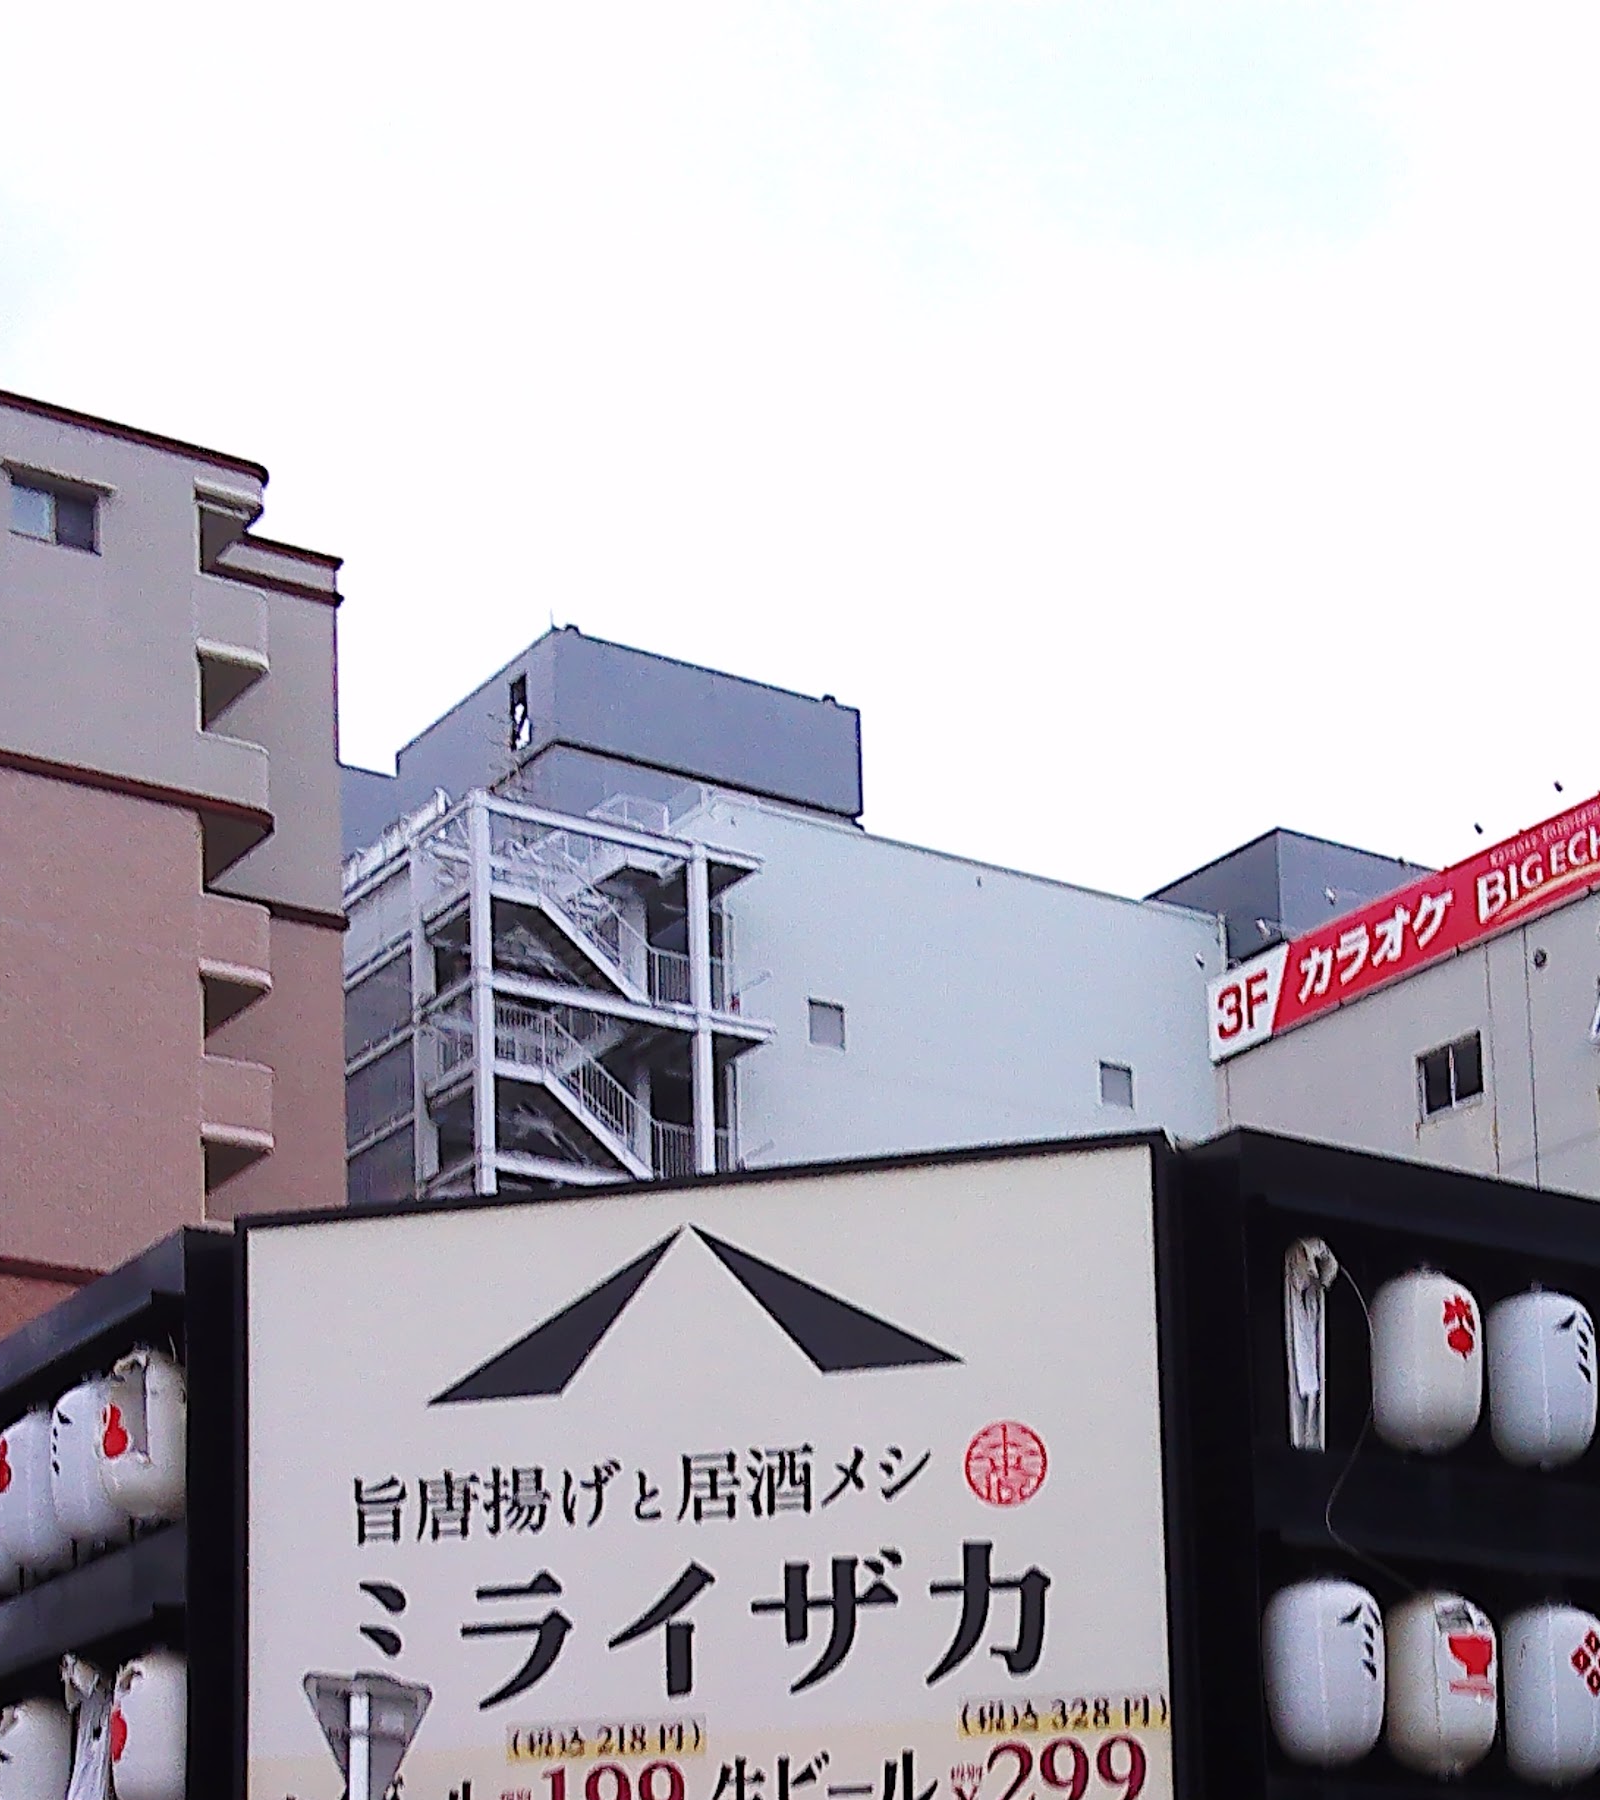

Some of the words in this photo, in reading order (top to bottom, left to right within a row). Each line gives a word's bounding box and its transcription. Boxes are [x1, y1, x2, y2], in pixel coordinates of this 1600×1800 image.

[1477, 851, 1544, 925] BIG
[1298, 888, 1455, 1005] カラオケ
[1218, 967, 1268, 1040] 3F
[353, 1443, 932, 1547] 旨唐揚げと居酒メシ
[358, 1541, 1051, 1710] ミライザカ
